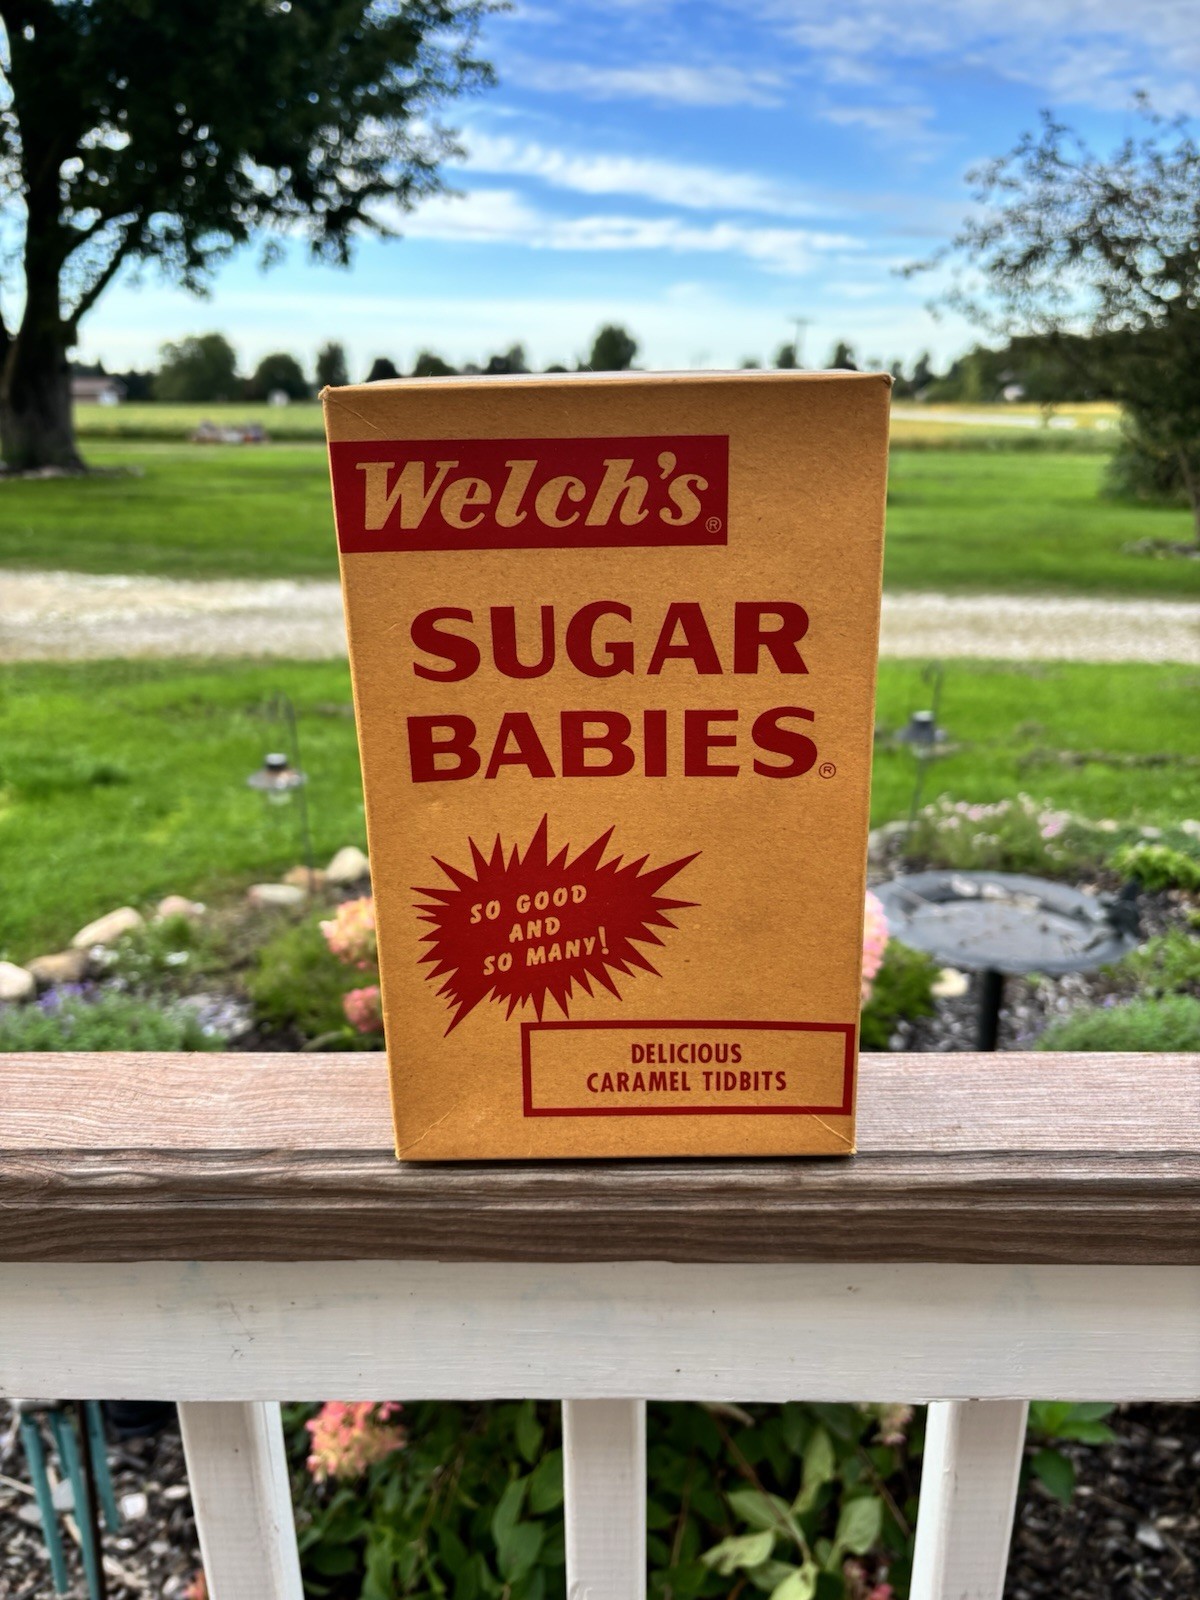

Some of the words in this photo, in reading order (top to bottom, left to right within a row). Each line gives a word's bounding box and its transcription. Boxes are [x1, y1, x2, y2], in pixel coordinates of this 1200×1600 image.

[355, 450, 709, 531] Welch's
[410, 600, 810, 683] SUGAR
[406, 706, 819, 783] BABIES
[469, 900, 501, 924] SO
[516, 884, 588, 914] GOOD
[482, 953, 514, 976] SO
[525, 925, 610, 967] MANY!
[508, 917, 561, 943] AND
[630, 1042, 743, 1065] DELICIOUS
[586, 1071, 692, 1093] CARAMEL
[702, 1070, 787, 1092] TIDBITS
